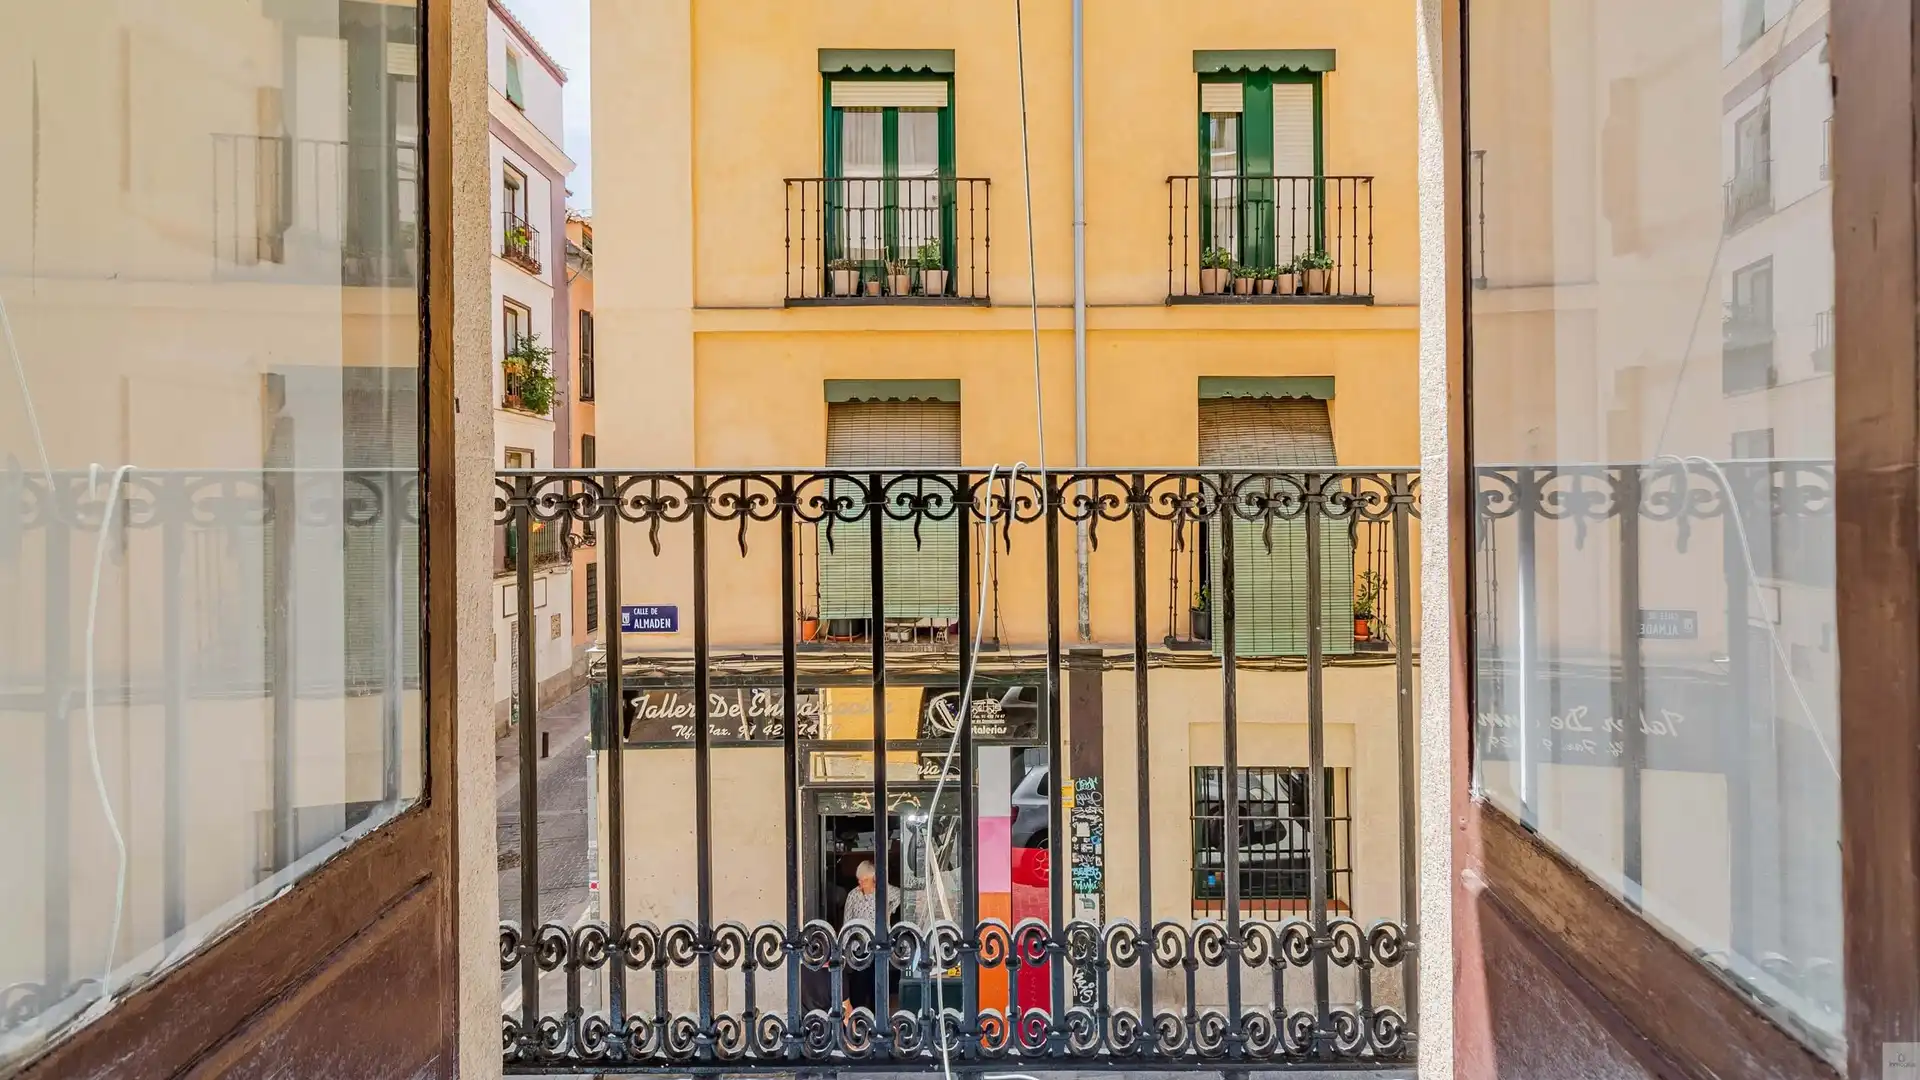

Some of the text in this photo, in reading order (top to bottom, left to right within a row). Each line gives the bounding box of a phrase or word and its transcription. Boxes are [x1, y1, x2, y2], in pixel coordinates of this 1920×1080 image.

[633, 607, 659, 615] CALLE DE
[633, 618, 671, 629] ALMADEN
[631, 692, 696, 720] Taller
[709, 693, 741, 717] De
